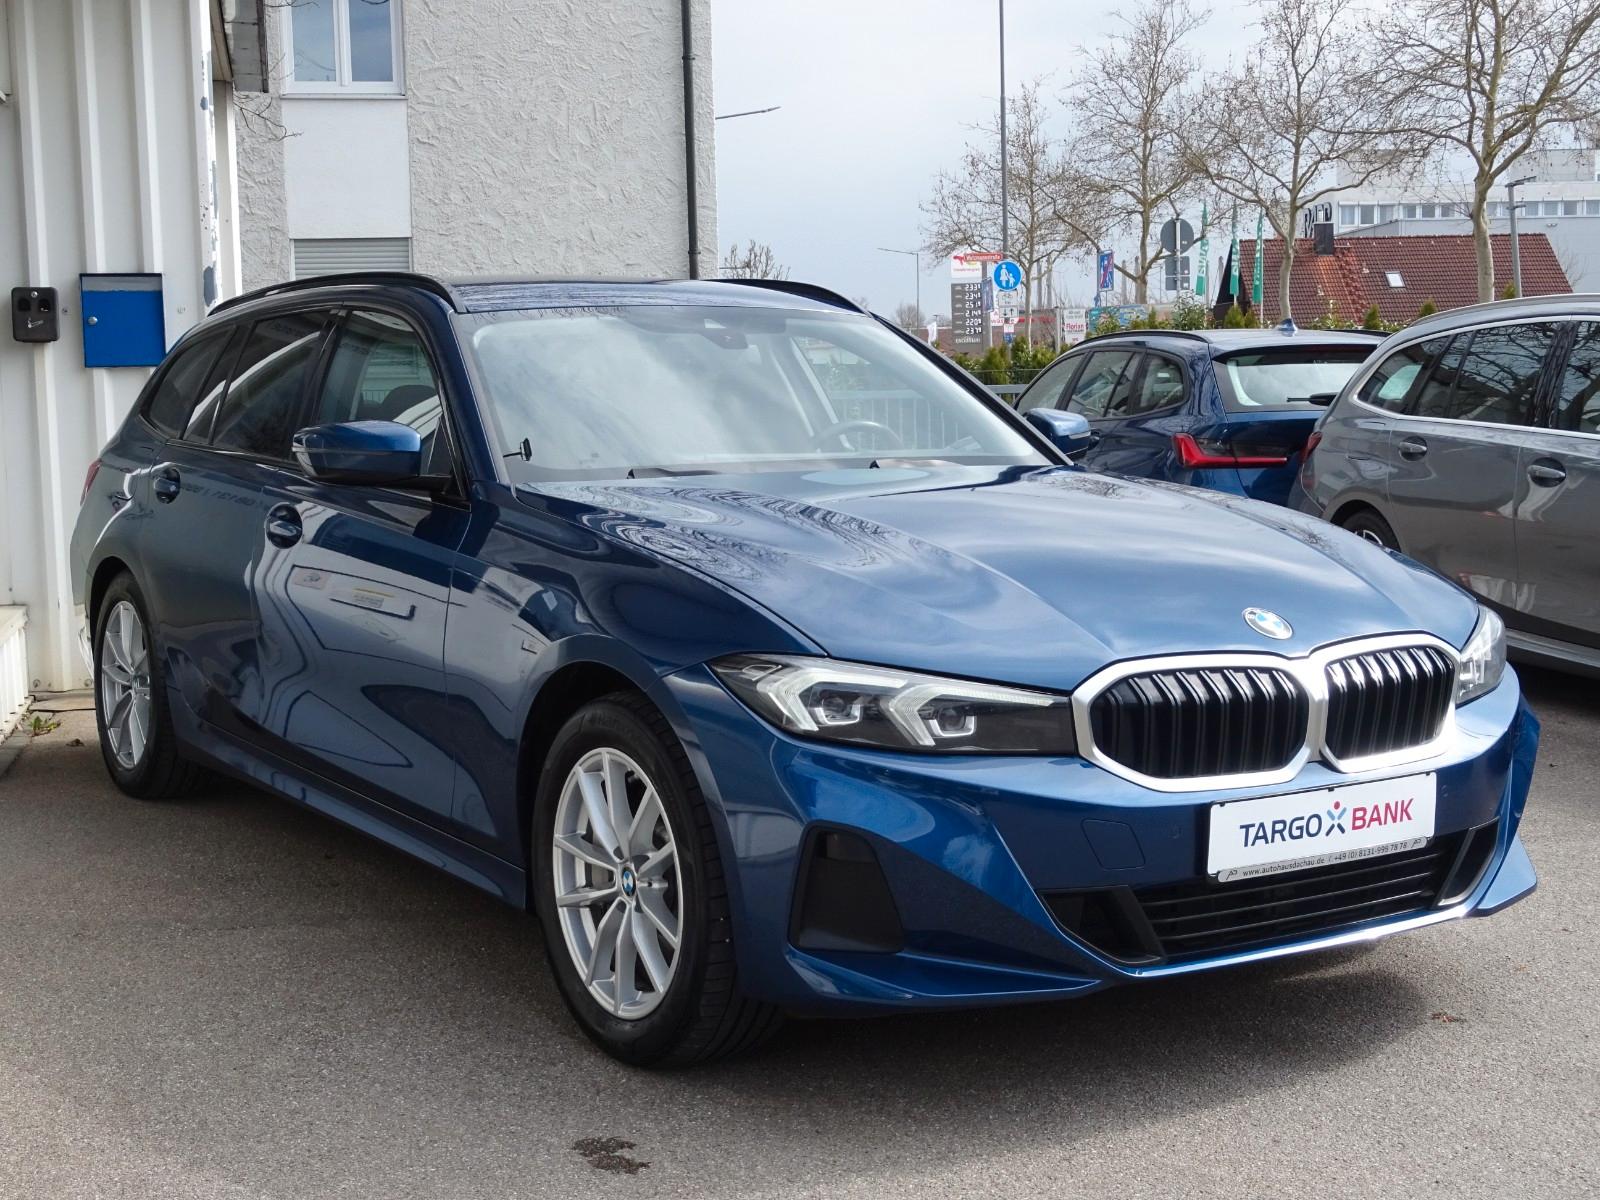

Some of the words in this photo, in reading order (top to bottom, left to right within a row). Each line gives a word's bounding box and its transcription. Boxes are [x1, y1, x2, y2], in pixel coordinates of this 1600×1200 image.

[1239, 813, 1323, 848] TARGO
[1351, 798, 1414, 831] BANK
[1242, 857, 1326, 877] www.autohausdachau.de
